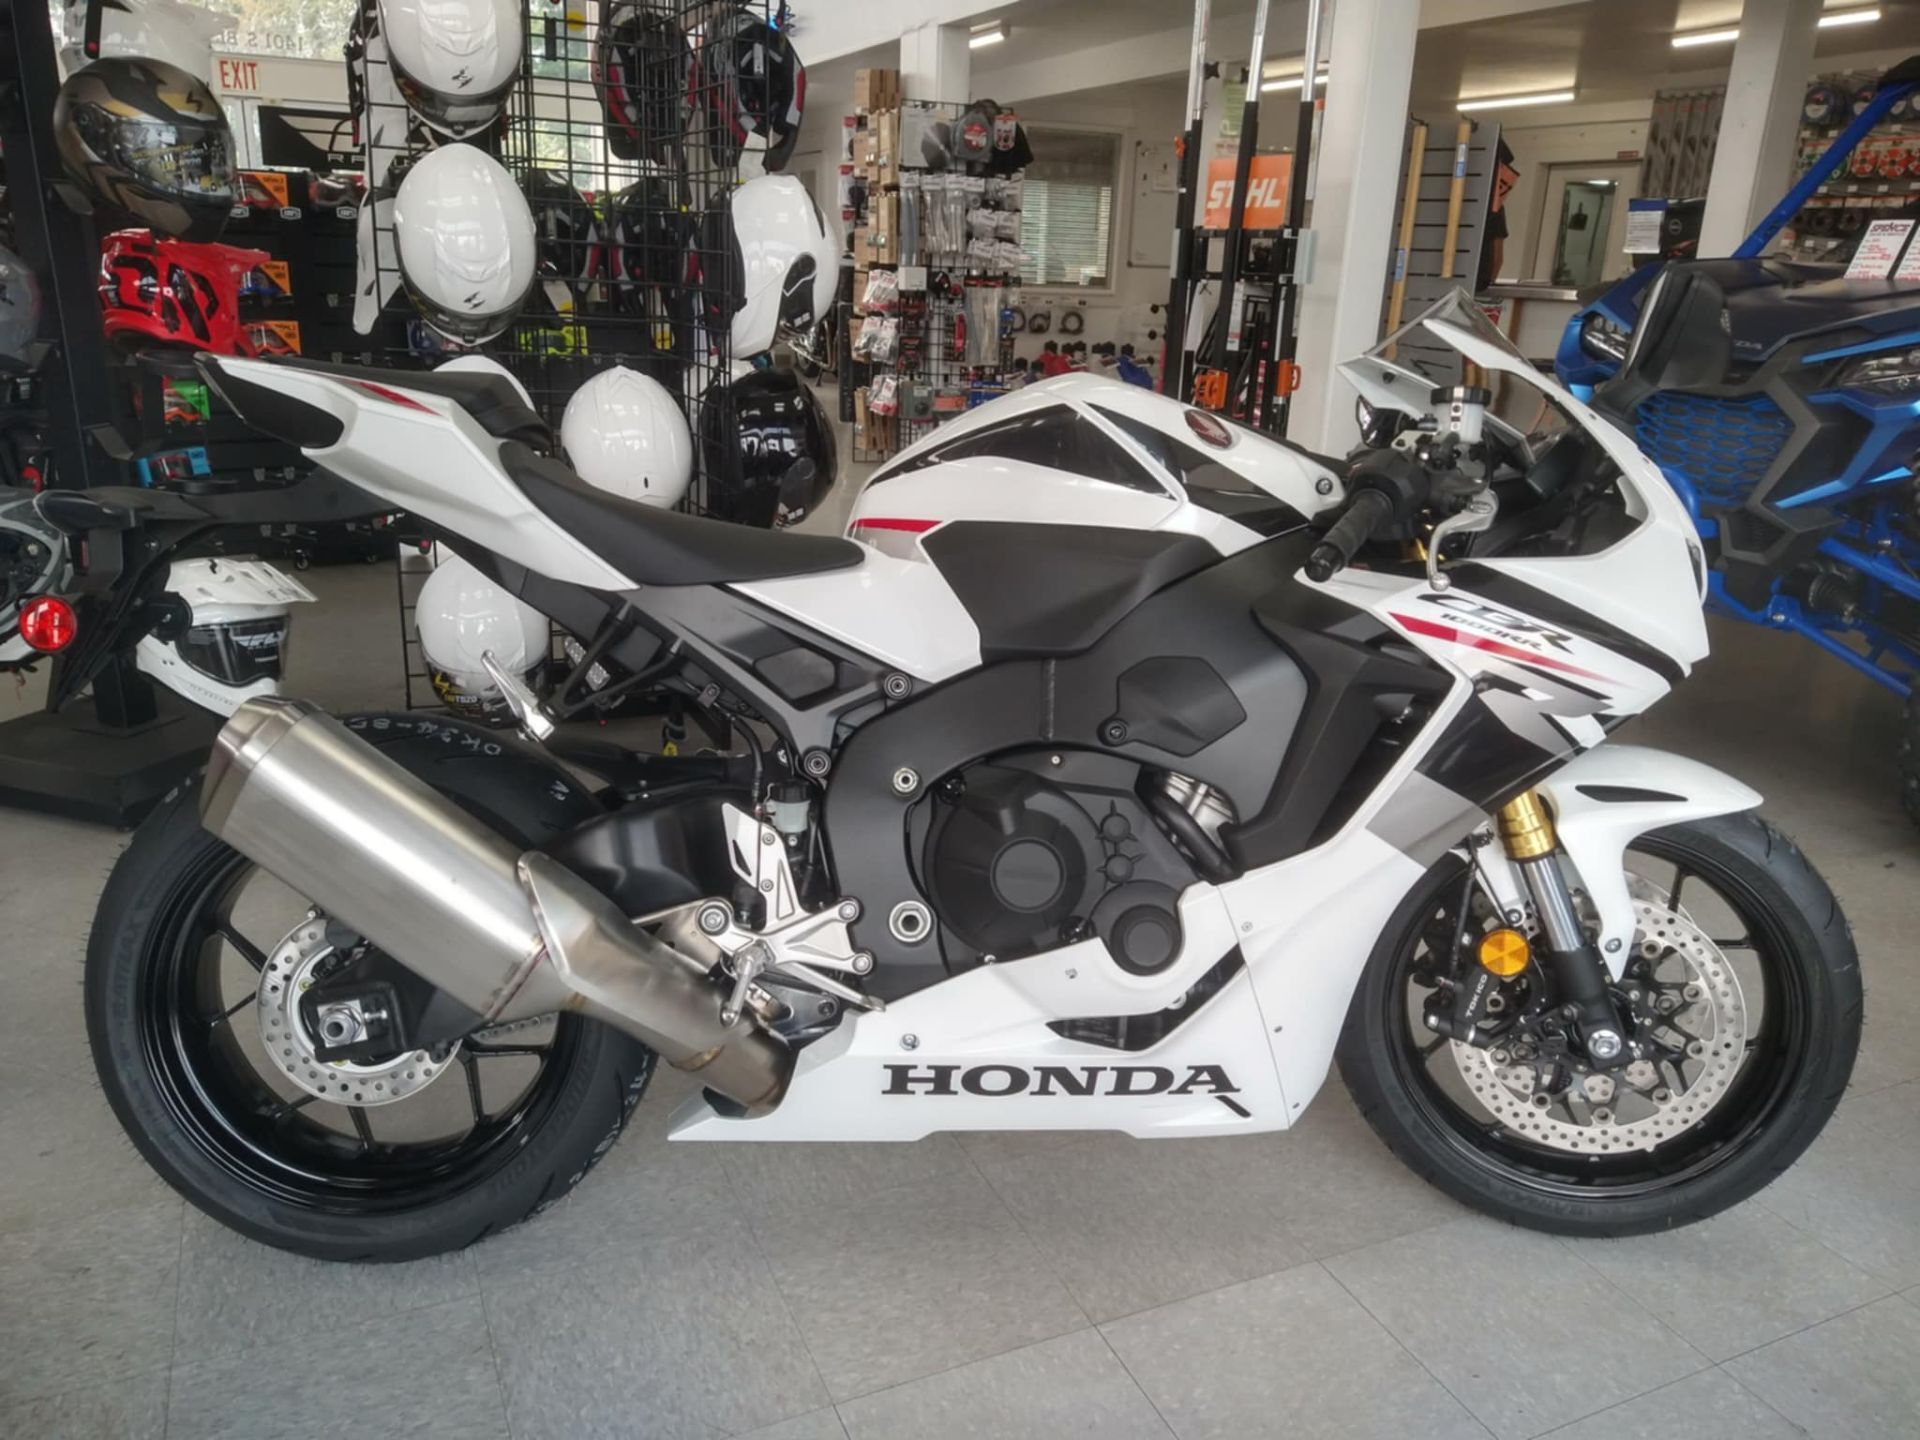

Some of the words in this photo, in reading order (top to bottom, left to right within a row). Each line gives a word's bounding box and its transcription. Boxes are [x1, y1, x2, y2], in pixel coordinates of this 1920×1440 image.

[219, 60, 257, 91] EXIT
[1206, 178, 1281, 209] STHL
[1416, 593, 1575, 655] CBR
[1464, 973, 1488, 1018] TOKICO
[881, 1064, 1242, 1097] HONDA
